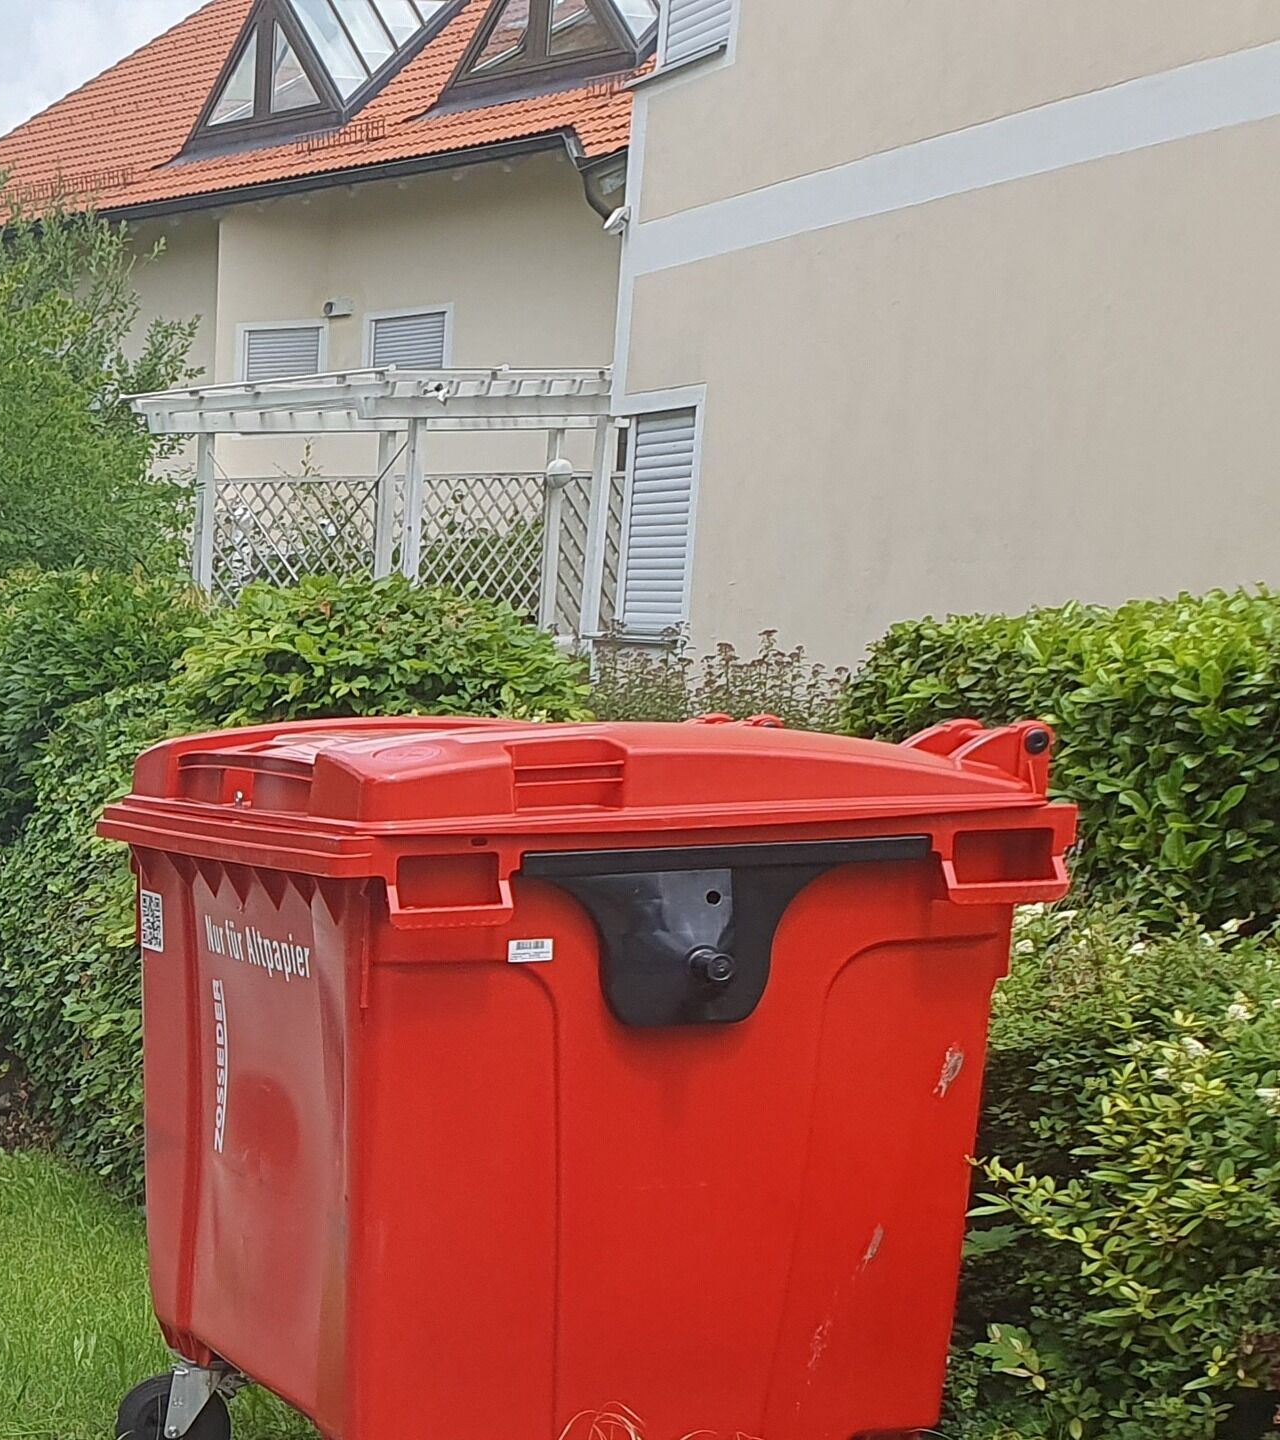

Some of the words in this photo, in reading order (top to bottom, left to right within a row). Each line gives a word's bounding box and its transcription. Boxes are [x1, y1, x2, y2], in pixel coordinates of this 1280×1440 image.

[204, 914, 224, 954] Nur
[226, 919, 243, 962] für
[244, 925, 311, 982] Altpapier
[212, 979, 227, 1154] ZOSSEDER
